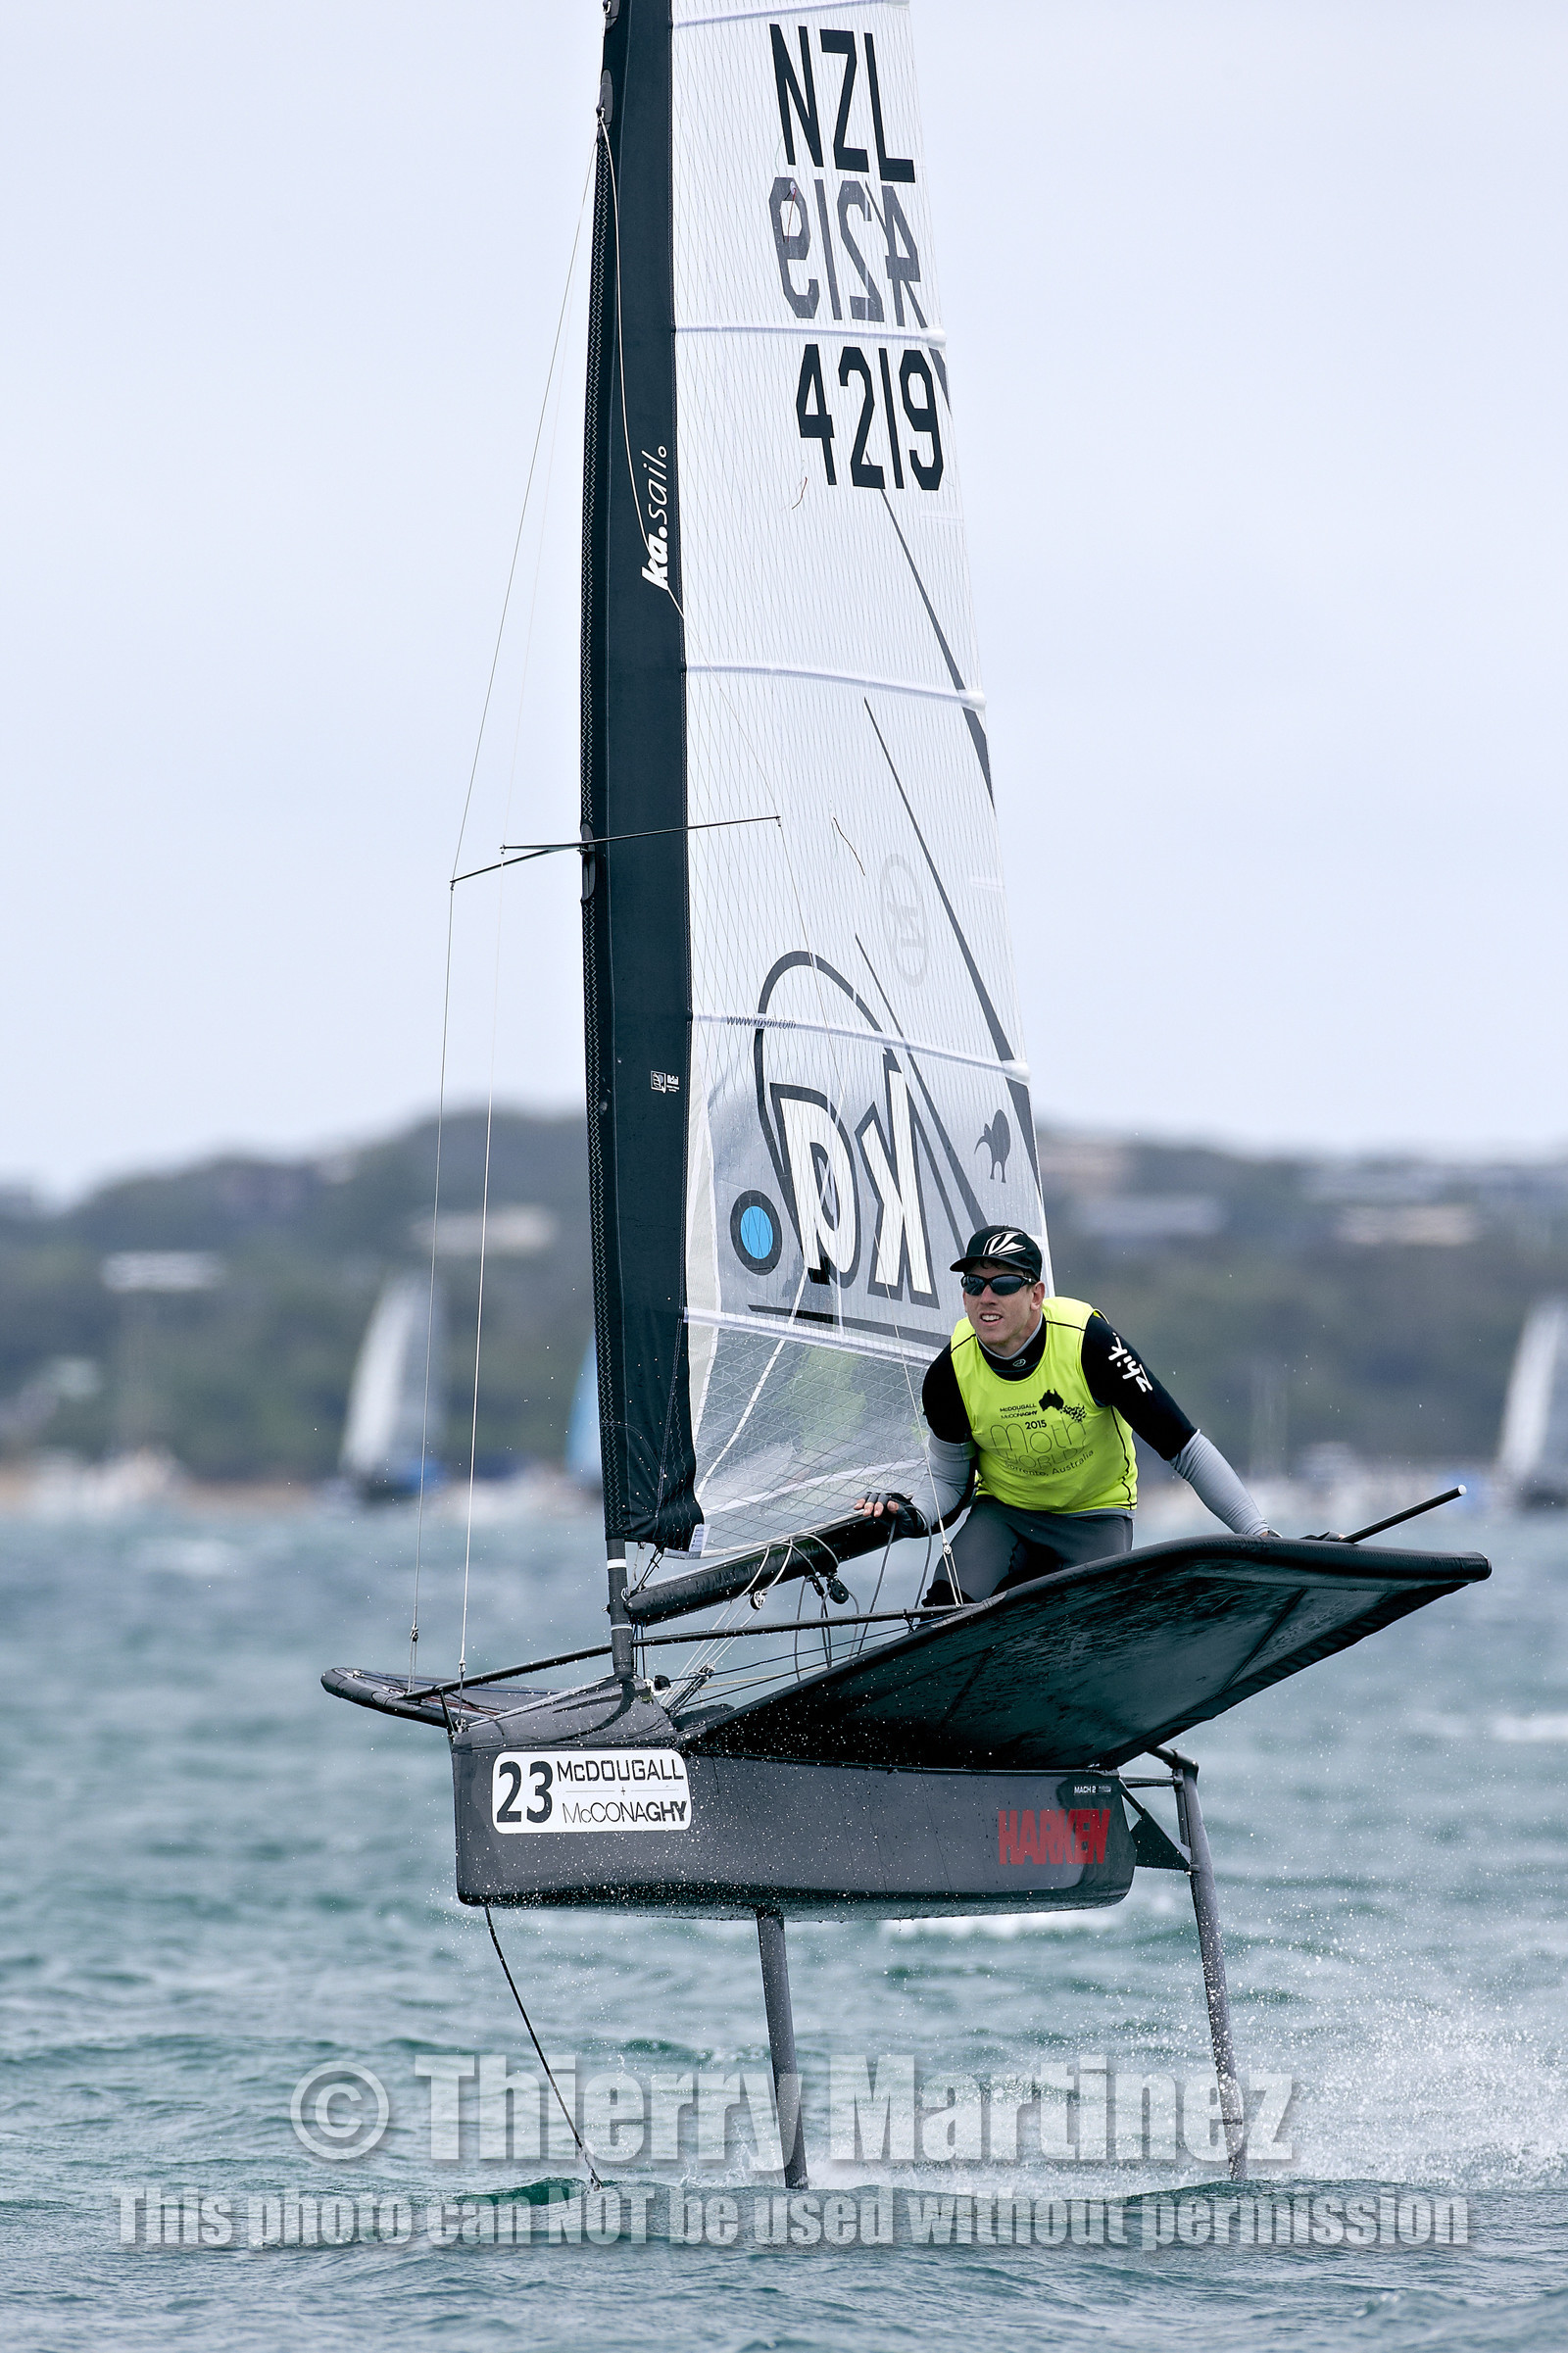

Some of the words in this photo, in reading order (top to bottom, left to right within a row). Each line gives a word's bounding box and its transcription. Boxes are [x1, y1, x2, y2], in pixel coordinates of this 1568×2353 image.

[769, 24, 915, 183] NZL
[796, 344, 944, 490] 4219
[1025, 1419, 1048, 1430] 2015
[1052, 1449, 1094, 1475] Australia
[557, 1759, 684, 1782] McDOUGALL
[496, 1760, 554, 1823] 23
[1074, 1786, 1092, 1794] MACH
[563, 1800, 687, 1823] McCONAGHY
[998, 1808, 1111, 1866] HARKEN
